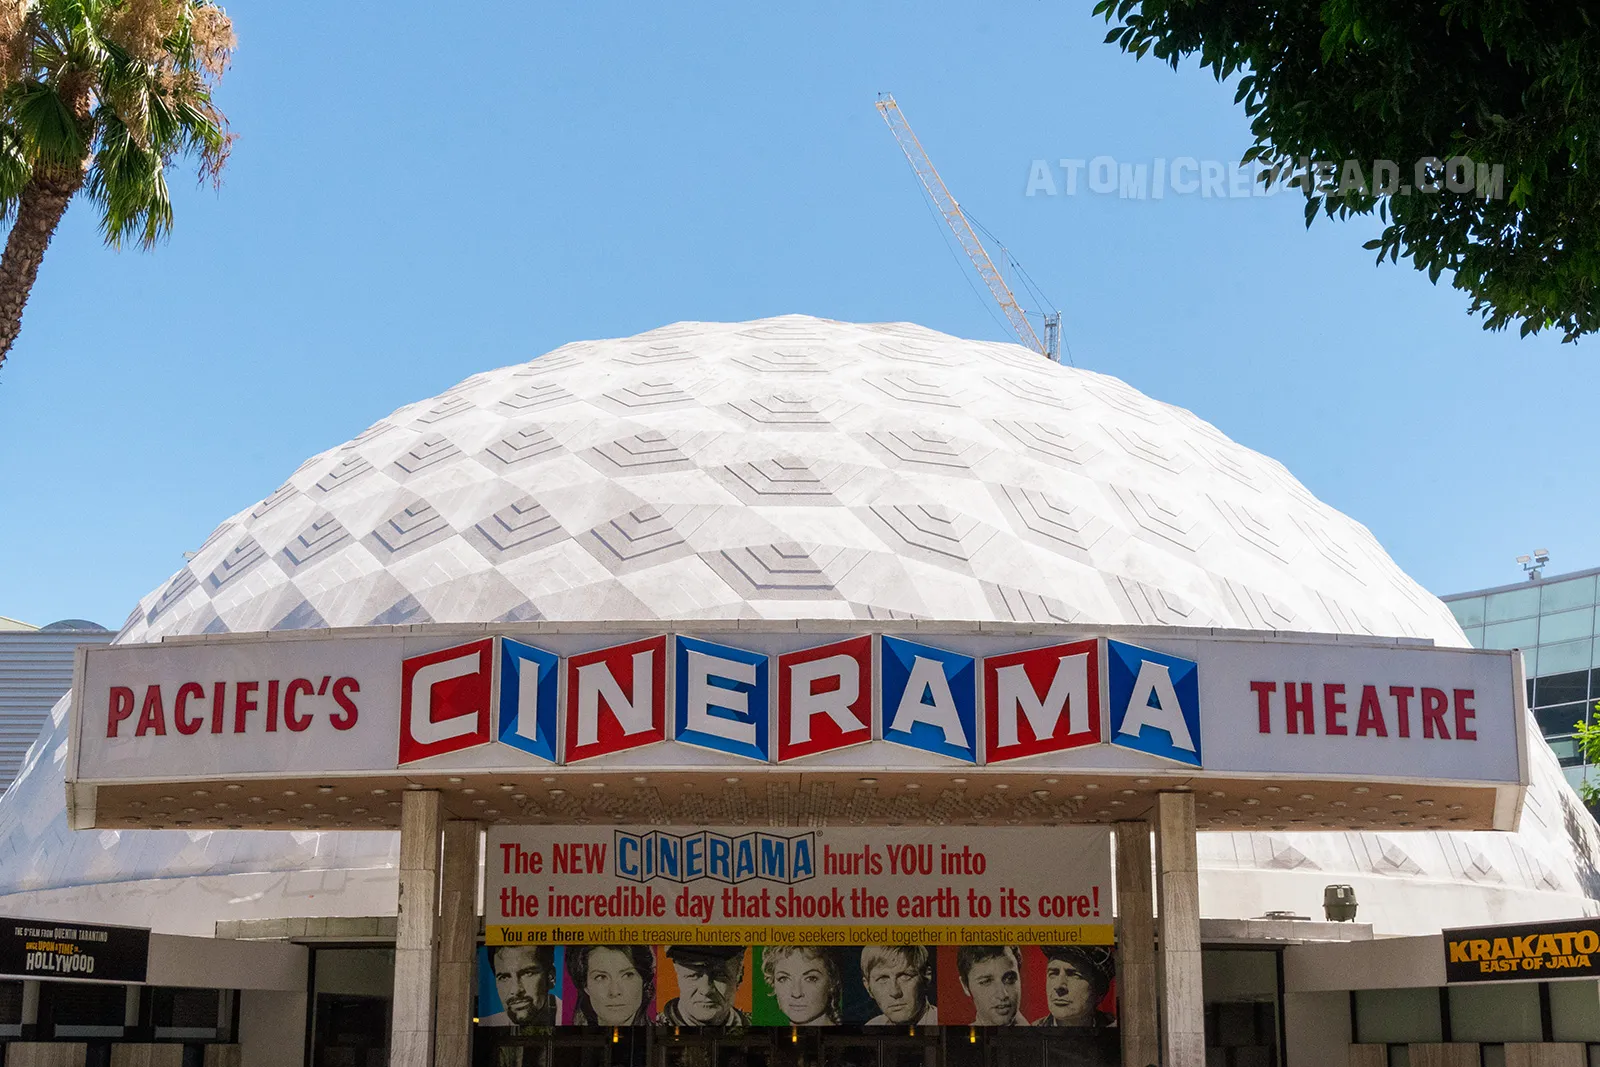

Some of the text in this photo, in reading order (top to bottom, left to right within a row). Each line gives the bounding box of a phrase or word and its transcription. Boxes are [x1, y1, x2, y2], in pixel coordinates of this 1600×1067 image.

[107, 650, 1477, 752] PACIFIC'S CINERAMA THEATRE
[500, 843, 543, 874] The
[552, 843, 607, 874] NEW
[824, 844, 883, 875] hurls
[886, 844, 933, 875] YOU
[941, 844, 986, 875] into
[500, 886, 1100, 923] the incredible day that shook the earth to its core!
[501, 928, 1083, 945] You are there with the treasure hunters and love seekers locked together in fantastic adventure!
[1449, 930, 1600, 962] KRAKATO
[26, 952, 94, 973] HOLLYWOOD
[1480, 955, 1592, 973] EAST OF JAVA
